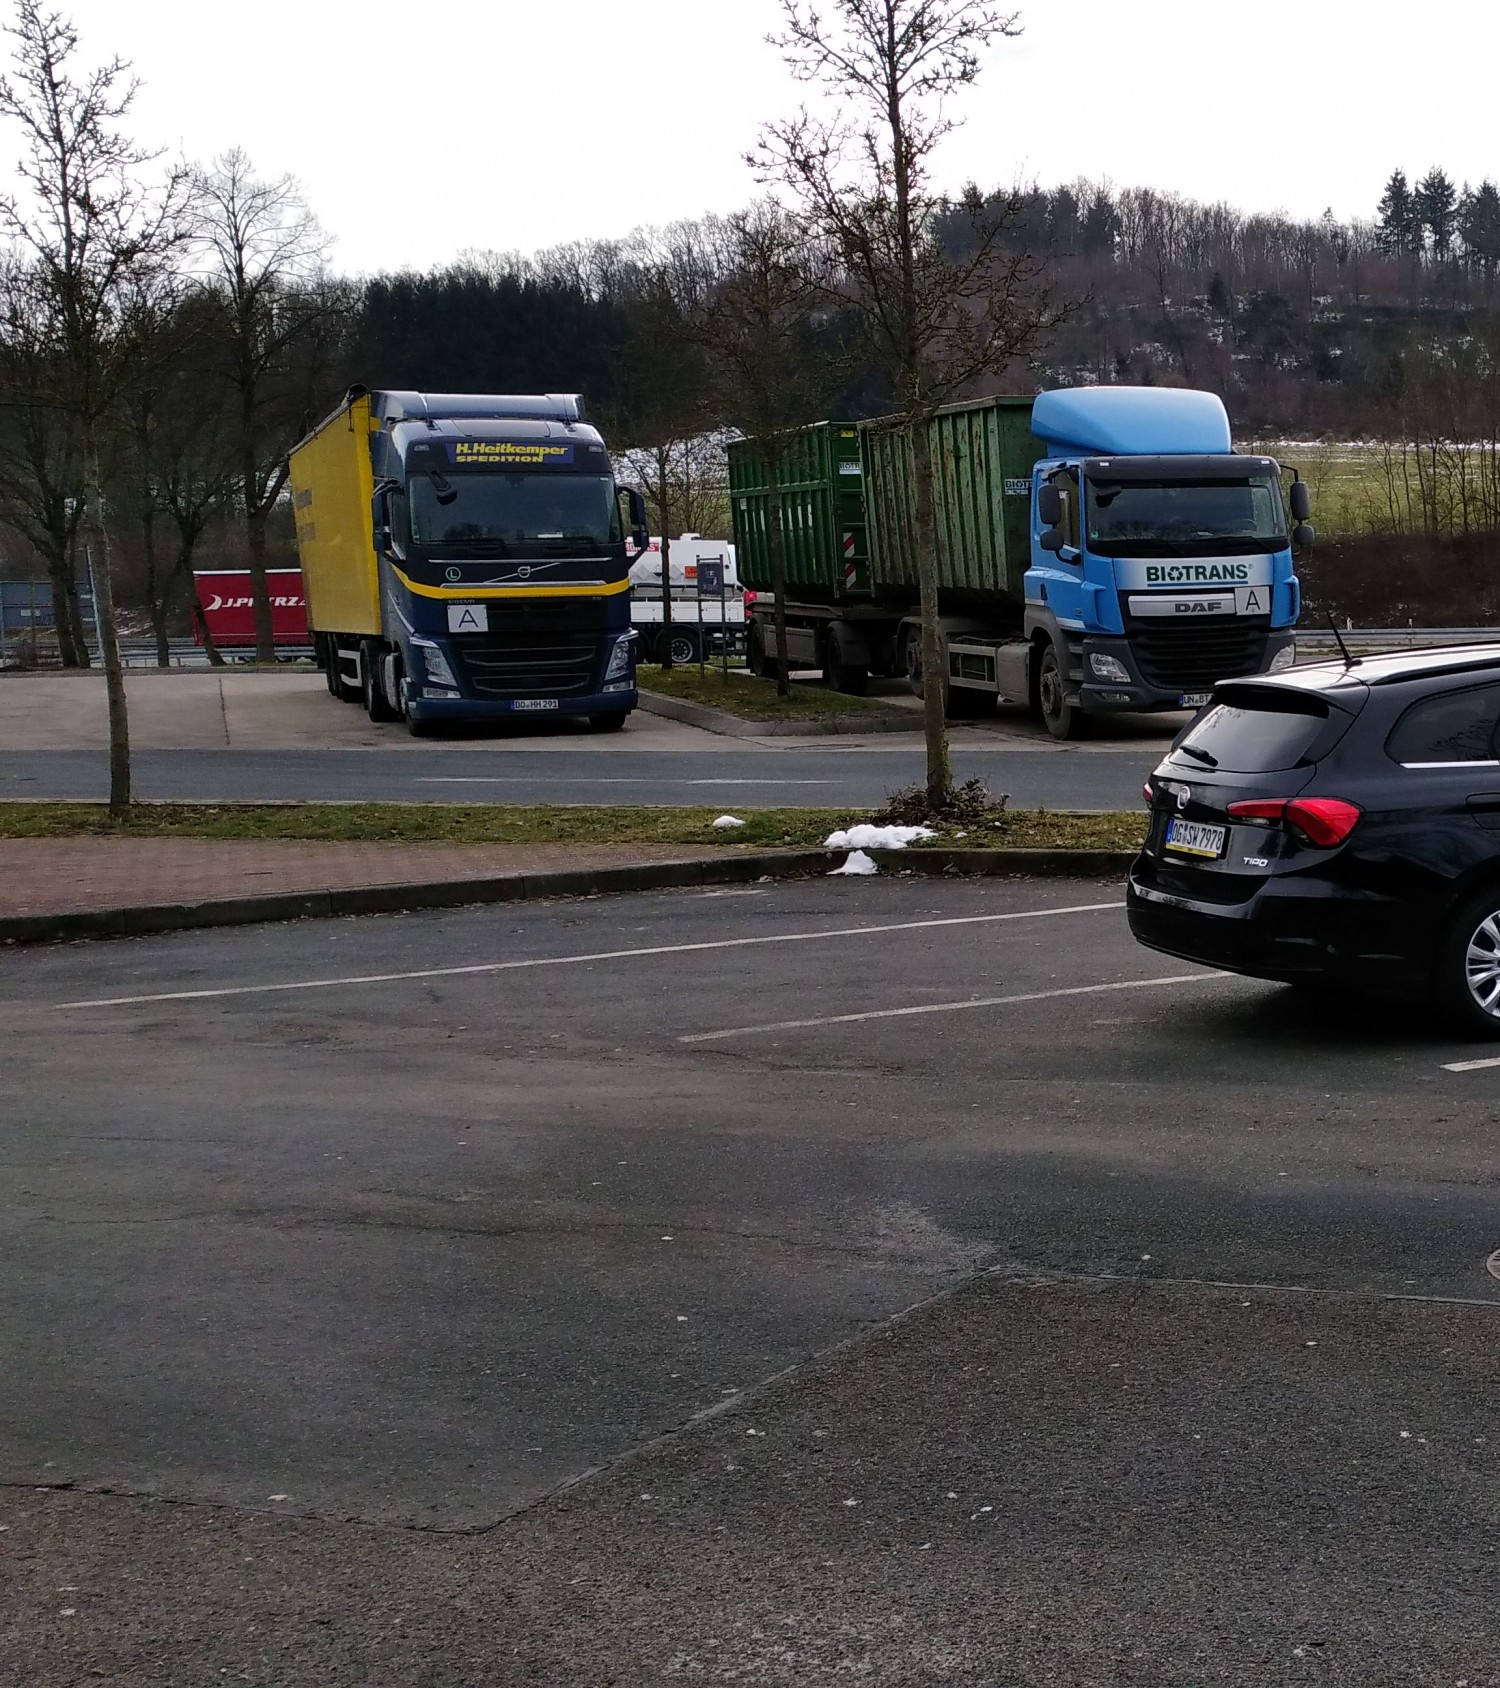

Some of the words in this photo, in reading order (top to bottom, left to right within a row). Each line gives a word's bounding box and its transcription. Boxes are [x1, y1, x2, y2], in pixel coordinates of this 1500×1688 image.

[456, 443, 568, 456] H.Heitkemper
[1175, 602, 1221, 613] DAF
[1245, 590, 1260, 611] A
[459, 609, 478, 628] A
[1200, 827, 1223, 851] 7978
[1243, 857, 1268, 867] TIPO
